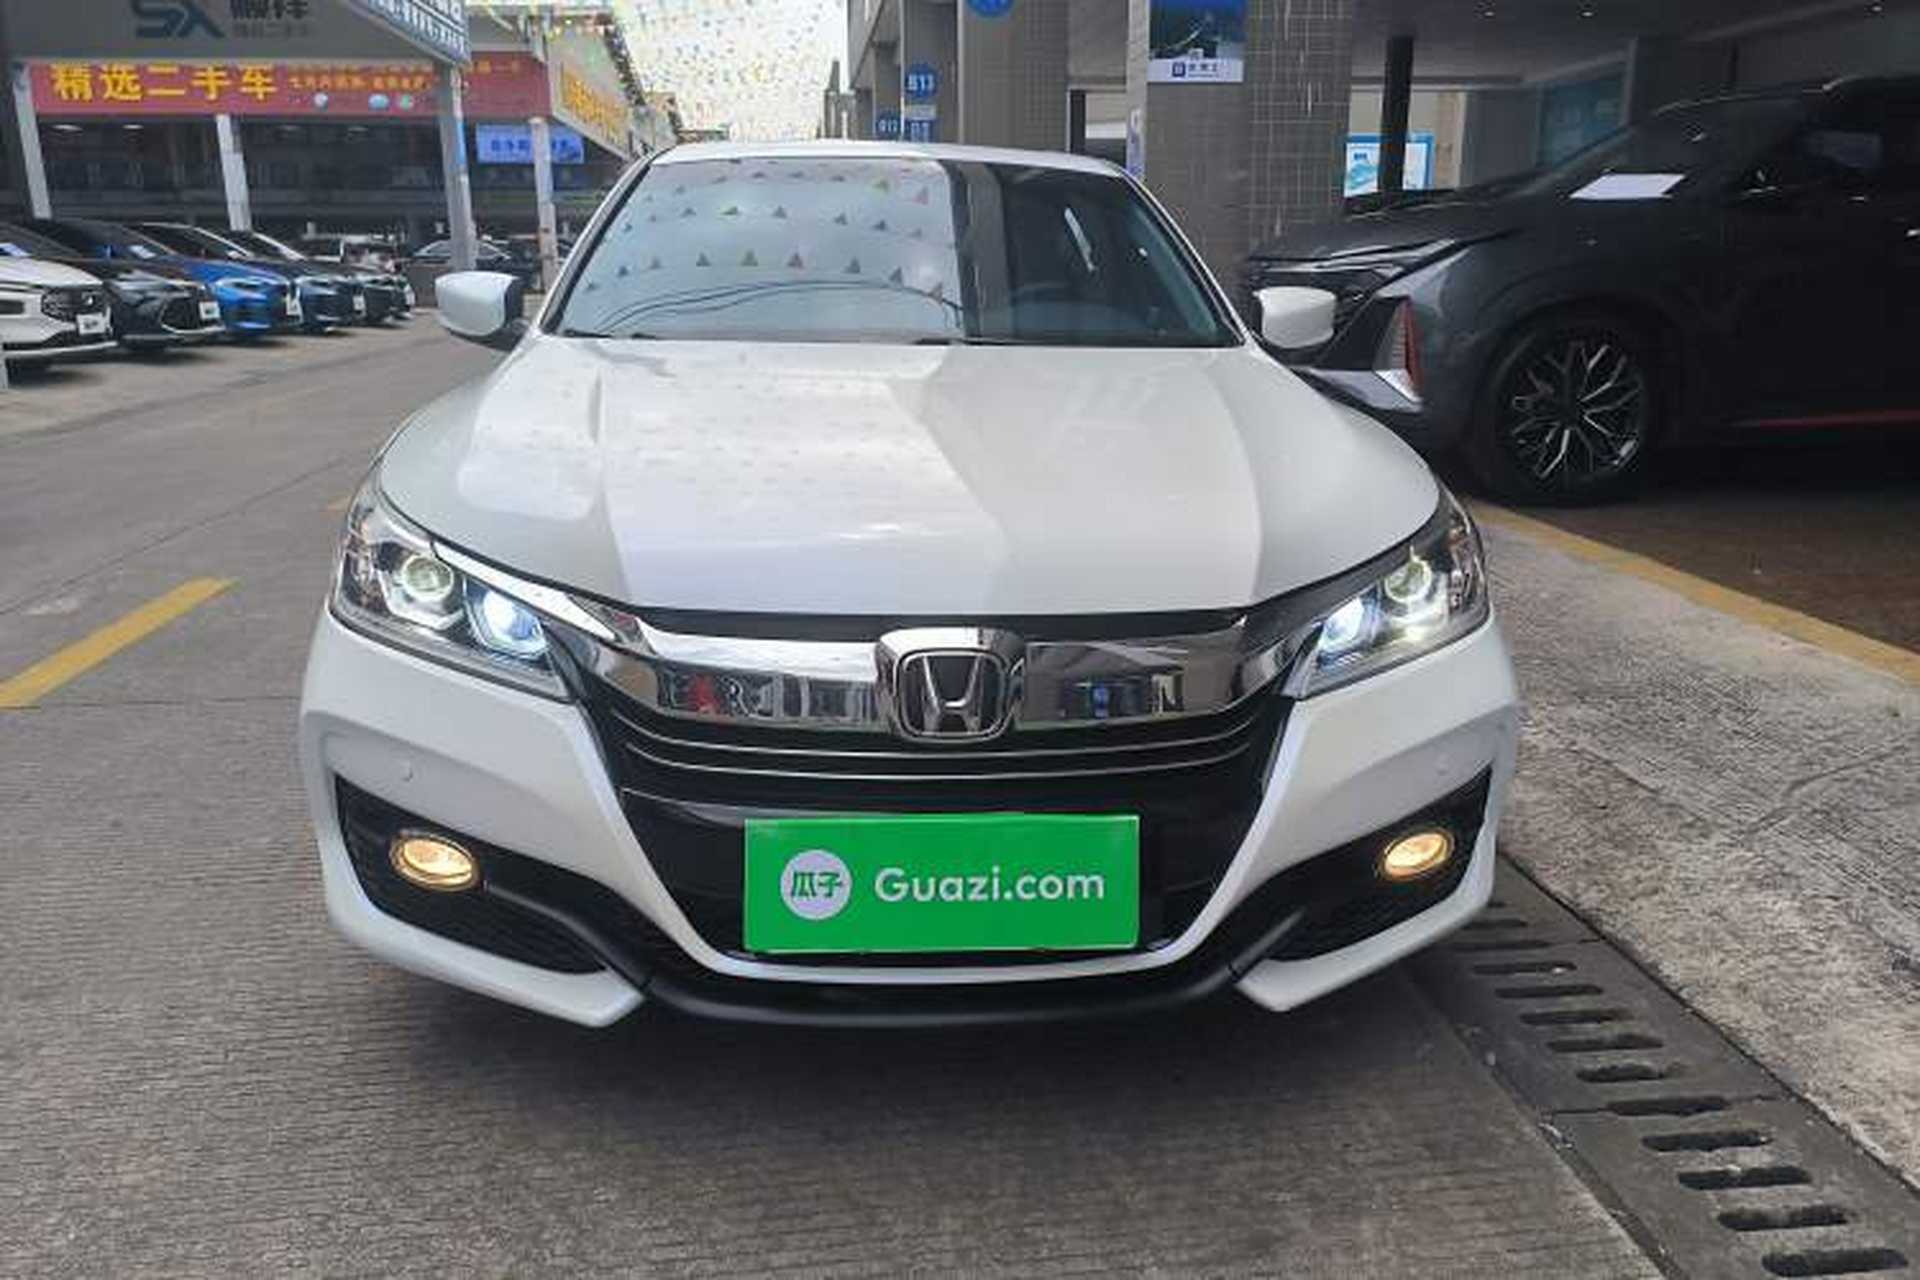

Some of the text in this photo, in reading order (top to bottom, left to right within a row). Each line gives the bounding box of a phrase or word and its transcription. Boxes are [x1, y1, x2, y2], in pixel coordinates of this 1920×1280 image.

[51, 63, 278, 100] 精选二手车
[791, 871, 843, 899] 瓜子
[874, 865, 1105, 902] Guazi.com
